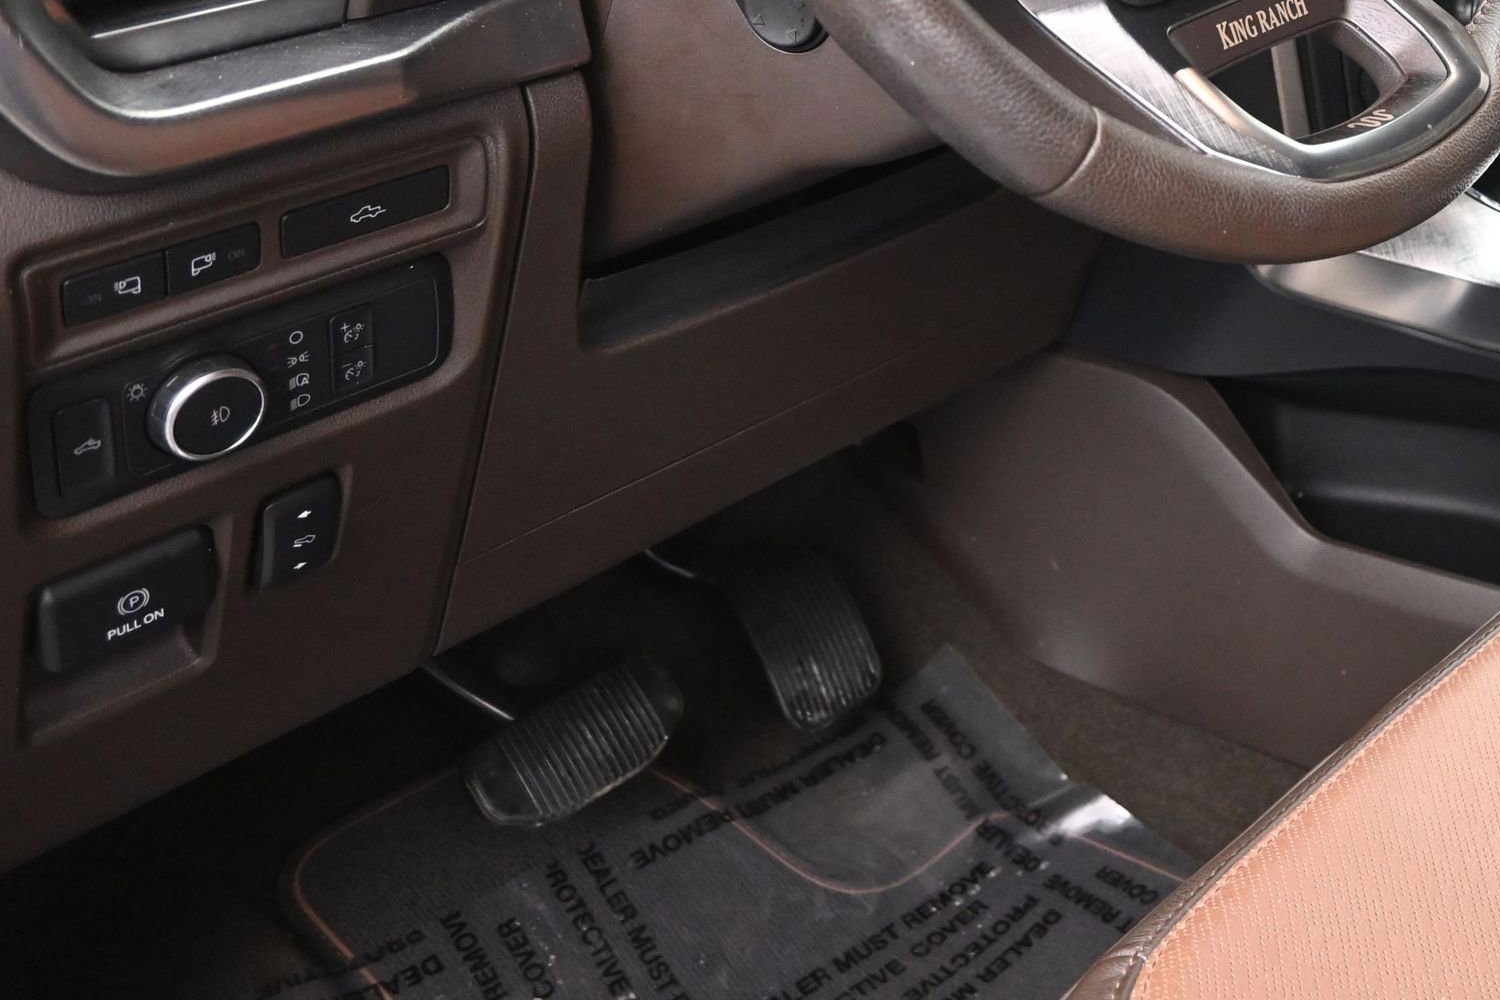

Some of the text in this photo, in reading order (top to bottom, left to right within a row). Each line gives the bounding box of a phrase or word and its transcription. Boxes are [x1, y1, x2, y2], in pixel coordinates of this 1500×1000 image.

[1216, 15, 1258, 50] KING
[107, 608, 164, 640] PULL ON
[921, 699, 976, 760] COVER
[628, 808, 736, 870] REMOVE
[1043, 873, 1122, 925] REMOVE
[1094, 864, 1159, 905] COVER
[831, 922, 901, 975] MUST
[902, 860, 994, 930] REMOVE
[901, 894, 1040, 1000] PROTECTIVE
[910, 899, 989, 958] COVER
[976, 908, 1063, 983] DEALER
[497, 916, 556, 999] COVER
[626, 922, 681, 992] MUST
